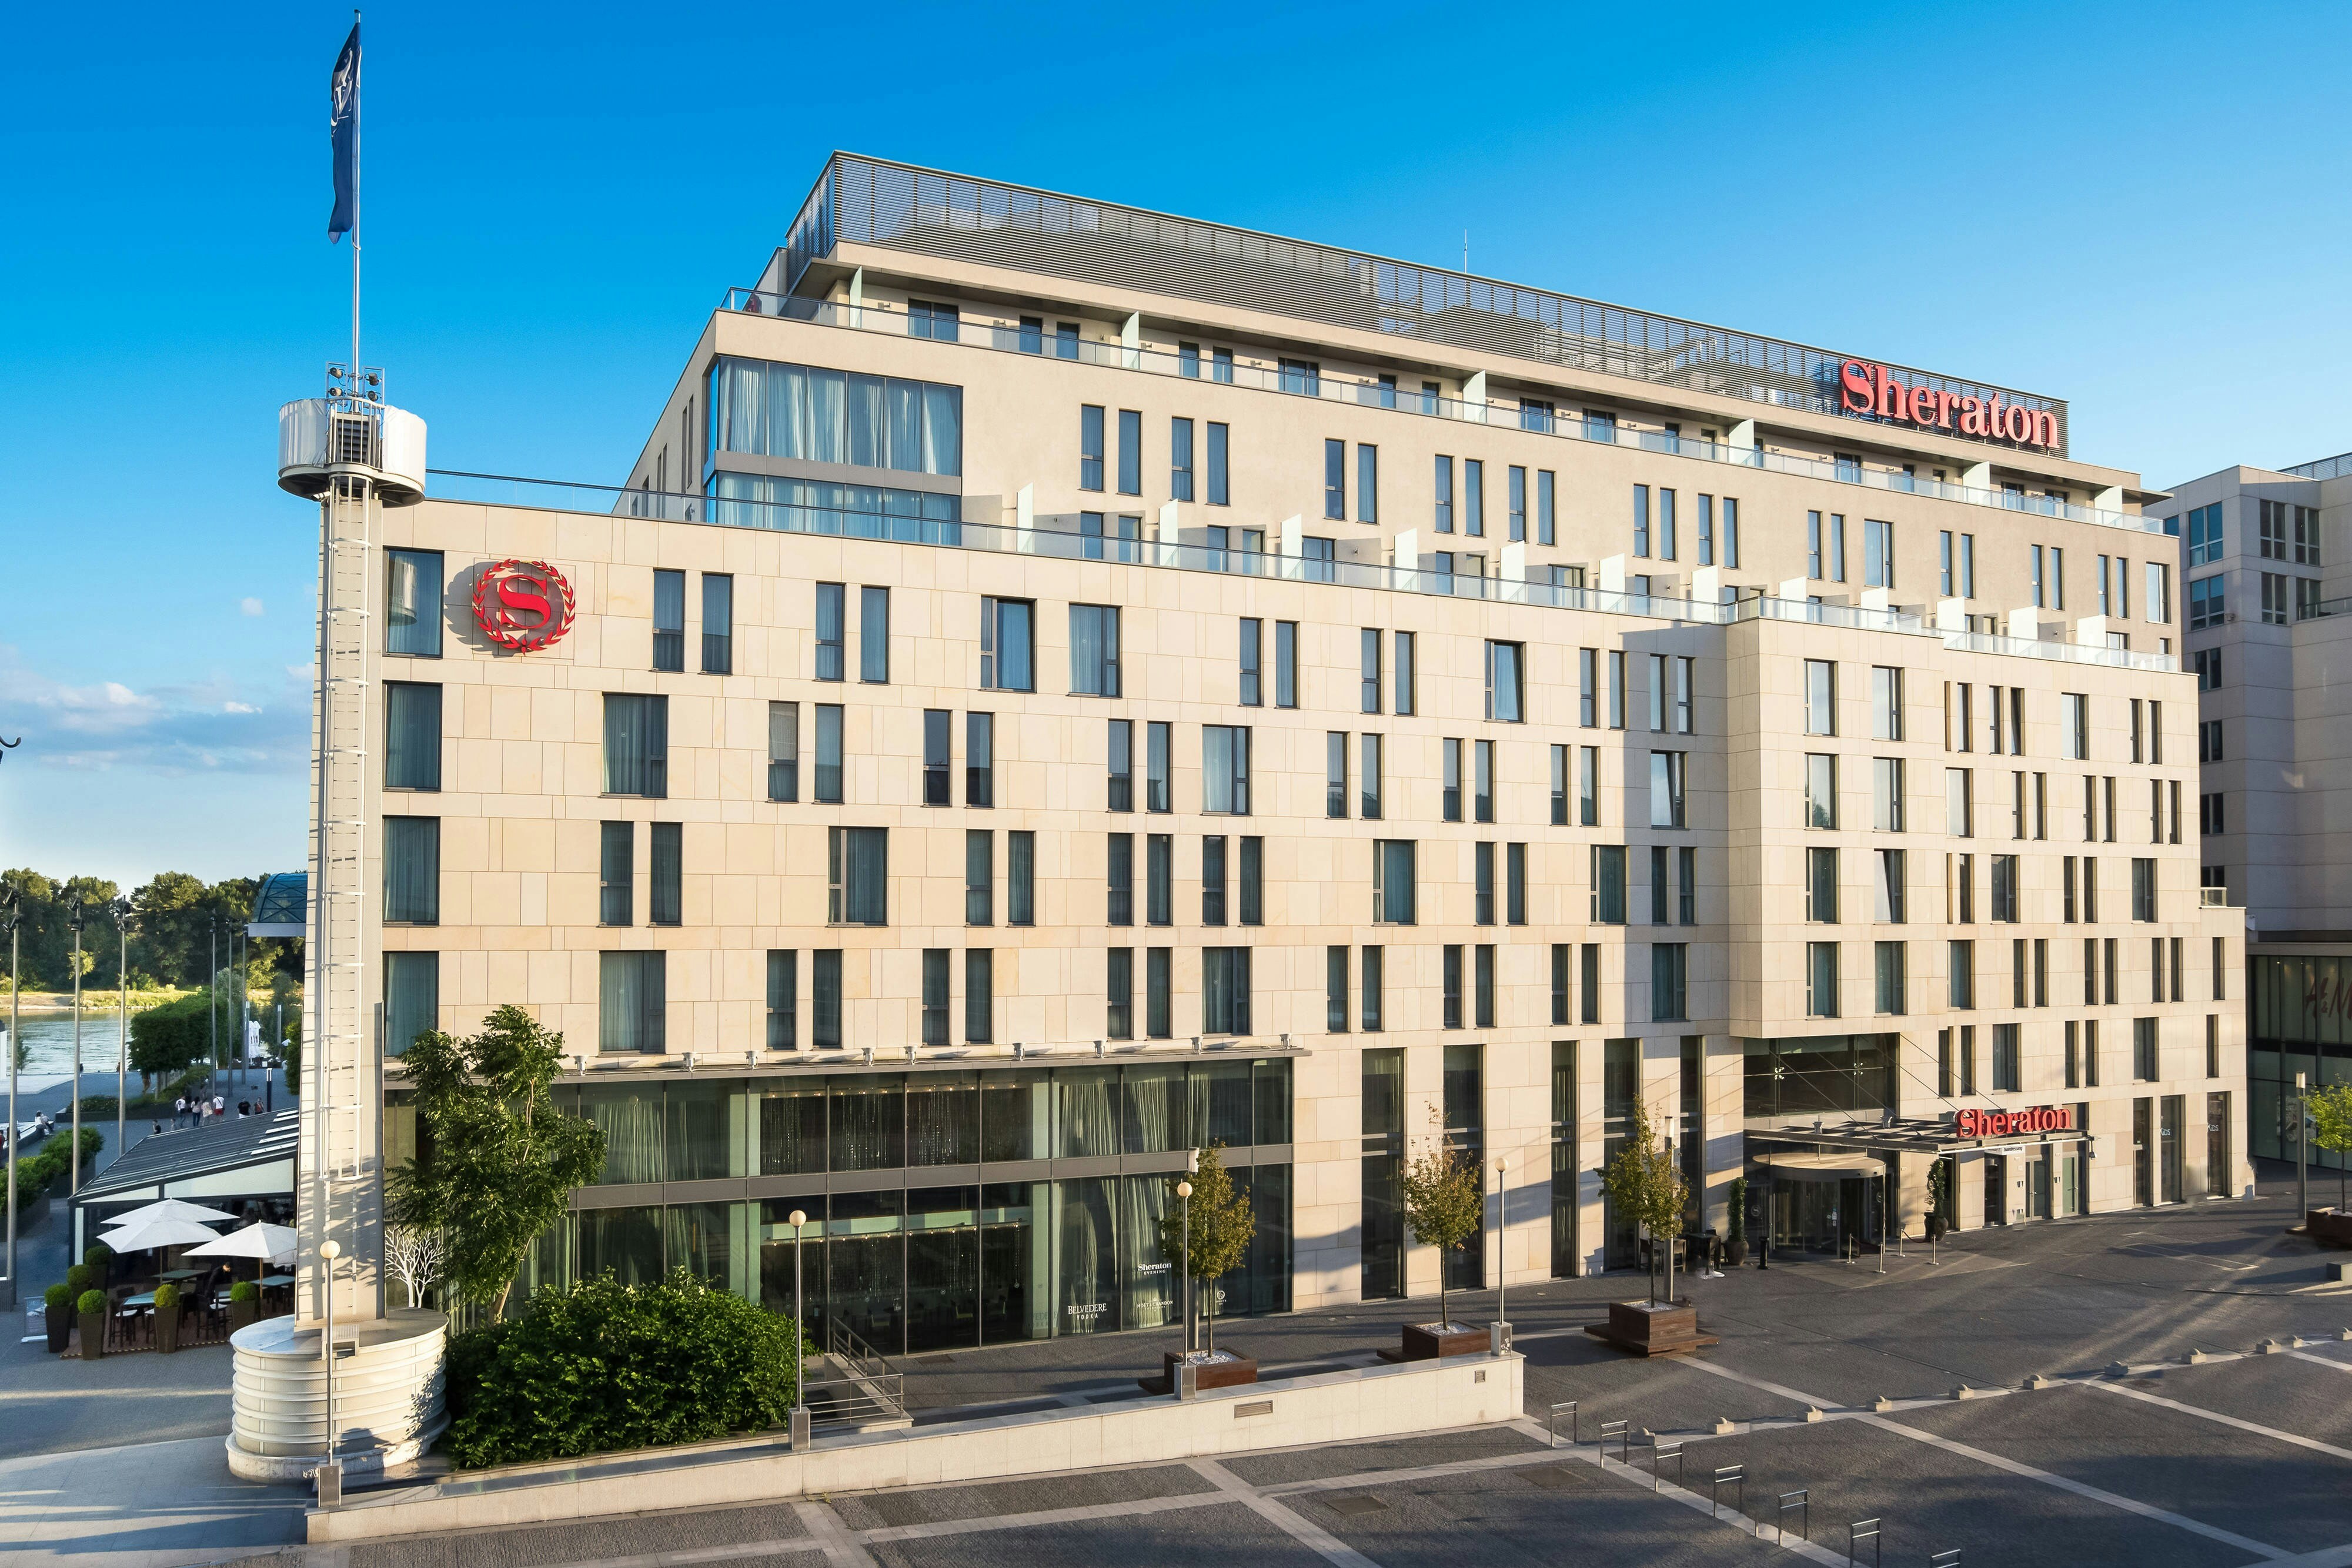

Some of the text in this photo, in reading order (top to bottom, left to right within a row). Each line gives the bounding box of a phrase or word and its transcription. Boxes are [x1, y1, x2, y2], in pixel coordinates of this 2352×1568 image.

[1841, 359, 2060, 449] Sheraton
[499, 574, 552, 630] S
[1957, 1106, 2072, 1138] Sheraton
[1138, 1263, 1171, 1271] Sheraton
[1068, 1303, 1107, 1315] BELVEDERE
